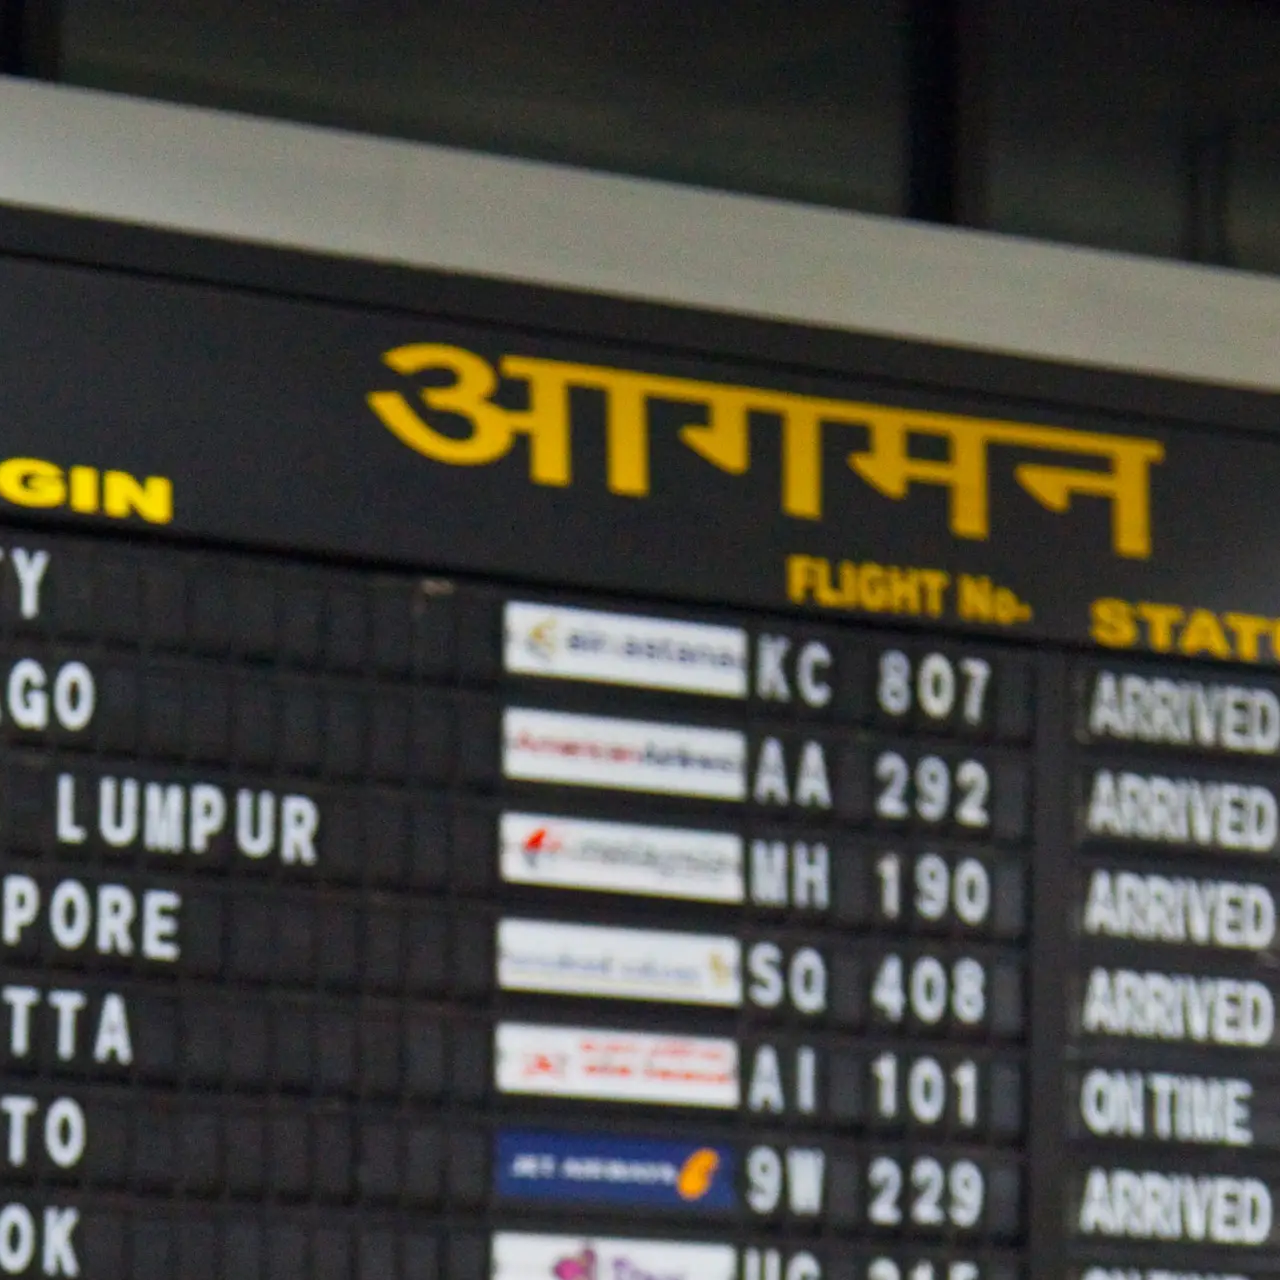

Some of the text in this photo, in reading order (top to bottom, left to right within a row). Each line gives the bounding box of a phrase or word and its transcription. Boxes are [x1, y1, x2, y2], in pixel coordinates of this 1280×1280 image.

[369, 340, 1168, 560] आगमन
[788, 556, 947, 615] FLIGHT
[759, 637, 829, 705] KC
[881, 652, 989, 720] 807
[756, 739, 830, 804] AA
[879, 753, 987, 825] 292
[1089, 772, 1278, 851] ARRIVED
[58, 775, 316, 862] LUMPUR
[879, 855, 989, 923] 190
[1086, 872, 1275, 949] ARRIVED
[874, 957, 984, 1022] 408
[1084, 970, 1274, 1046] ARRIVED
[750, 1047, 814, 1110] AI
[875, 1055, 976, 1123] 101
[1083, 1071, 1144, 1133] ON
[1151, 1074, 1252, 1144] TIME
[749, 1148, 823, 1211] 9W
[871, 1158, 983, 1226] 229
[1081, 1170, 1272, 1244] ARRIVED
